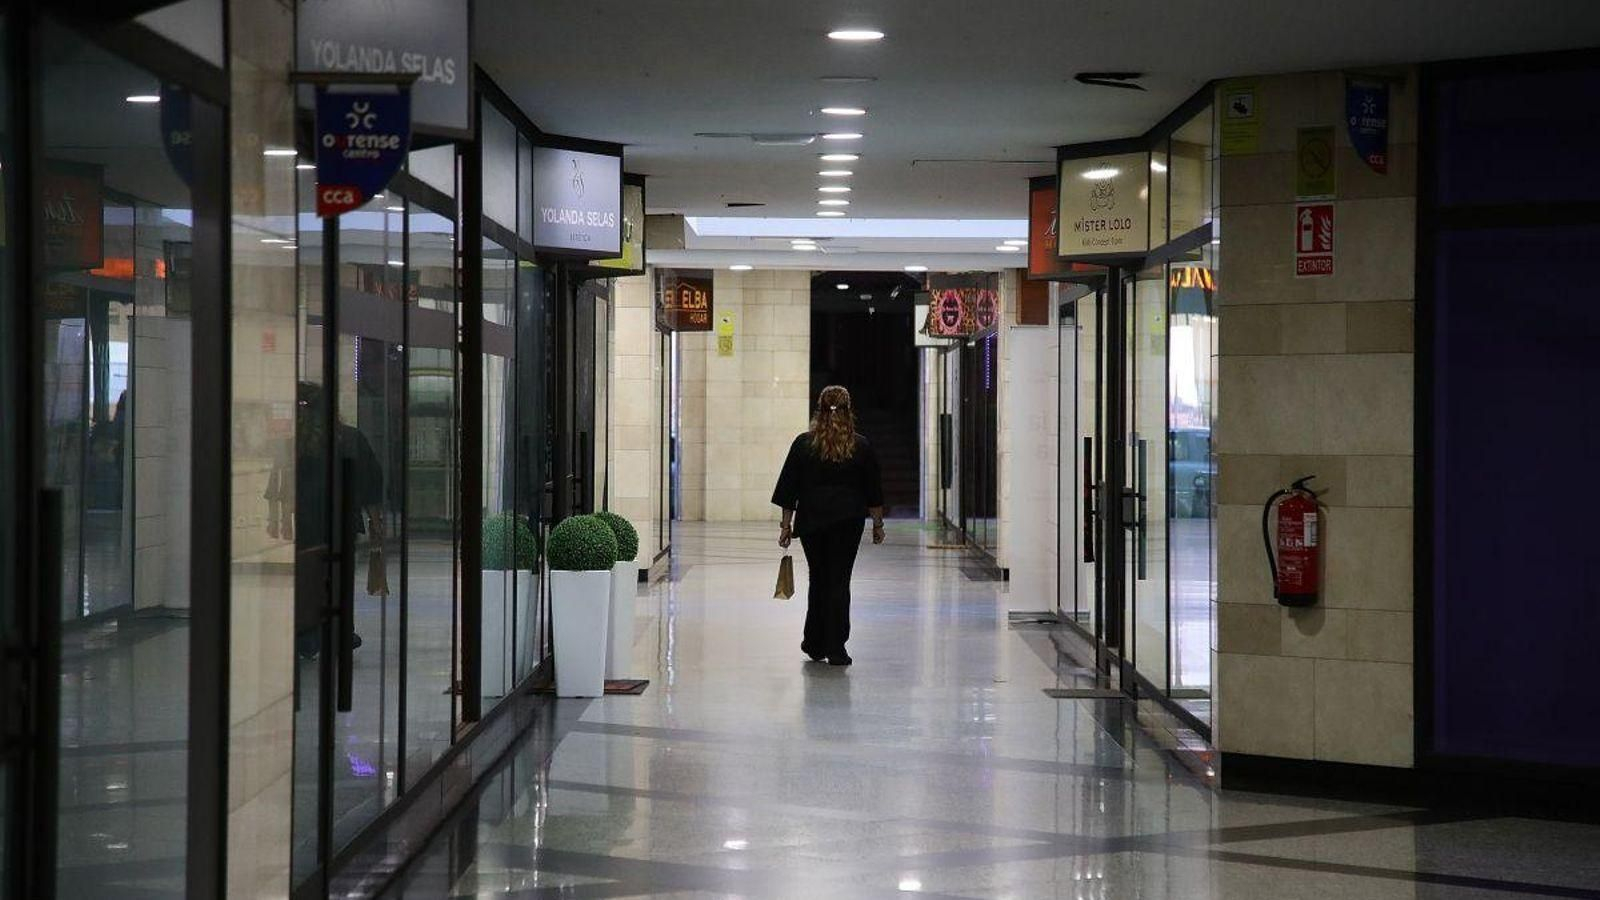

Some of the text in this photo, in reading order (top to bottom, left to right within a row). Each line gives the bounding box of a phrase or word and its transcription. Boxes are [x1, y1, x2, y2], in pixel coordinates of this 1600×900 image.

[311, 40, 456, 85] YOLANDA SELAS
[322, 190, 354, 205] cca
[541, 208, 615, 228] YOLANDA SELAS
[1109, 218, 1132, 231] LOLO
[682, 289, 708, 309] ELBA
